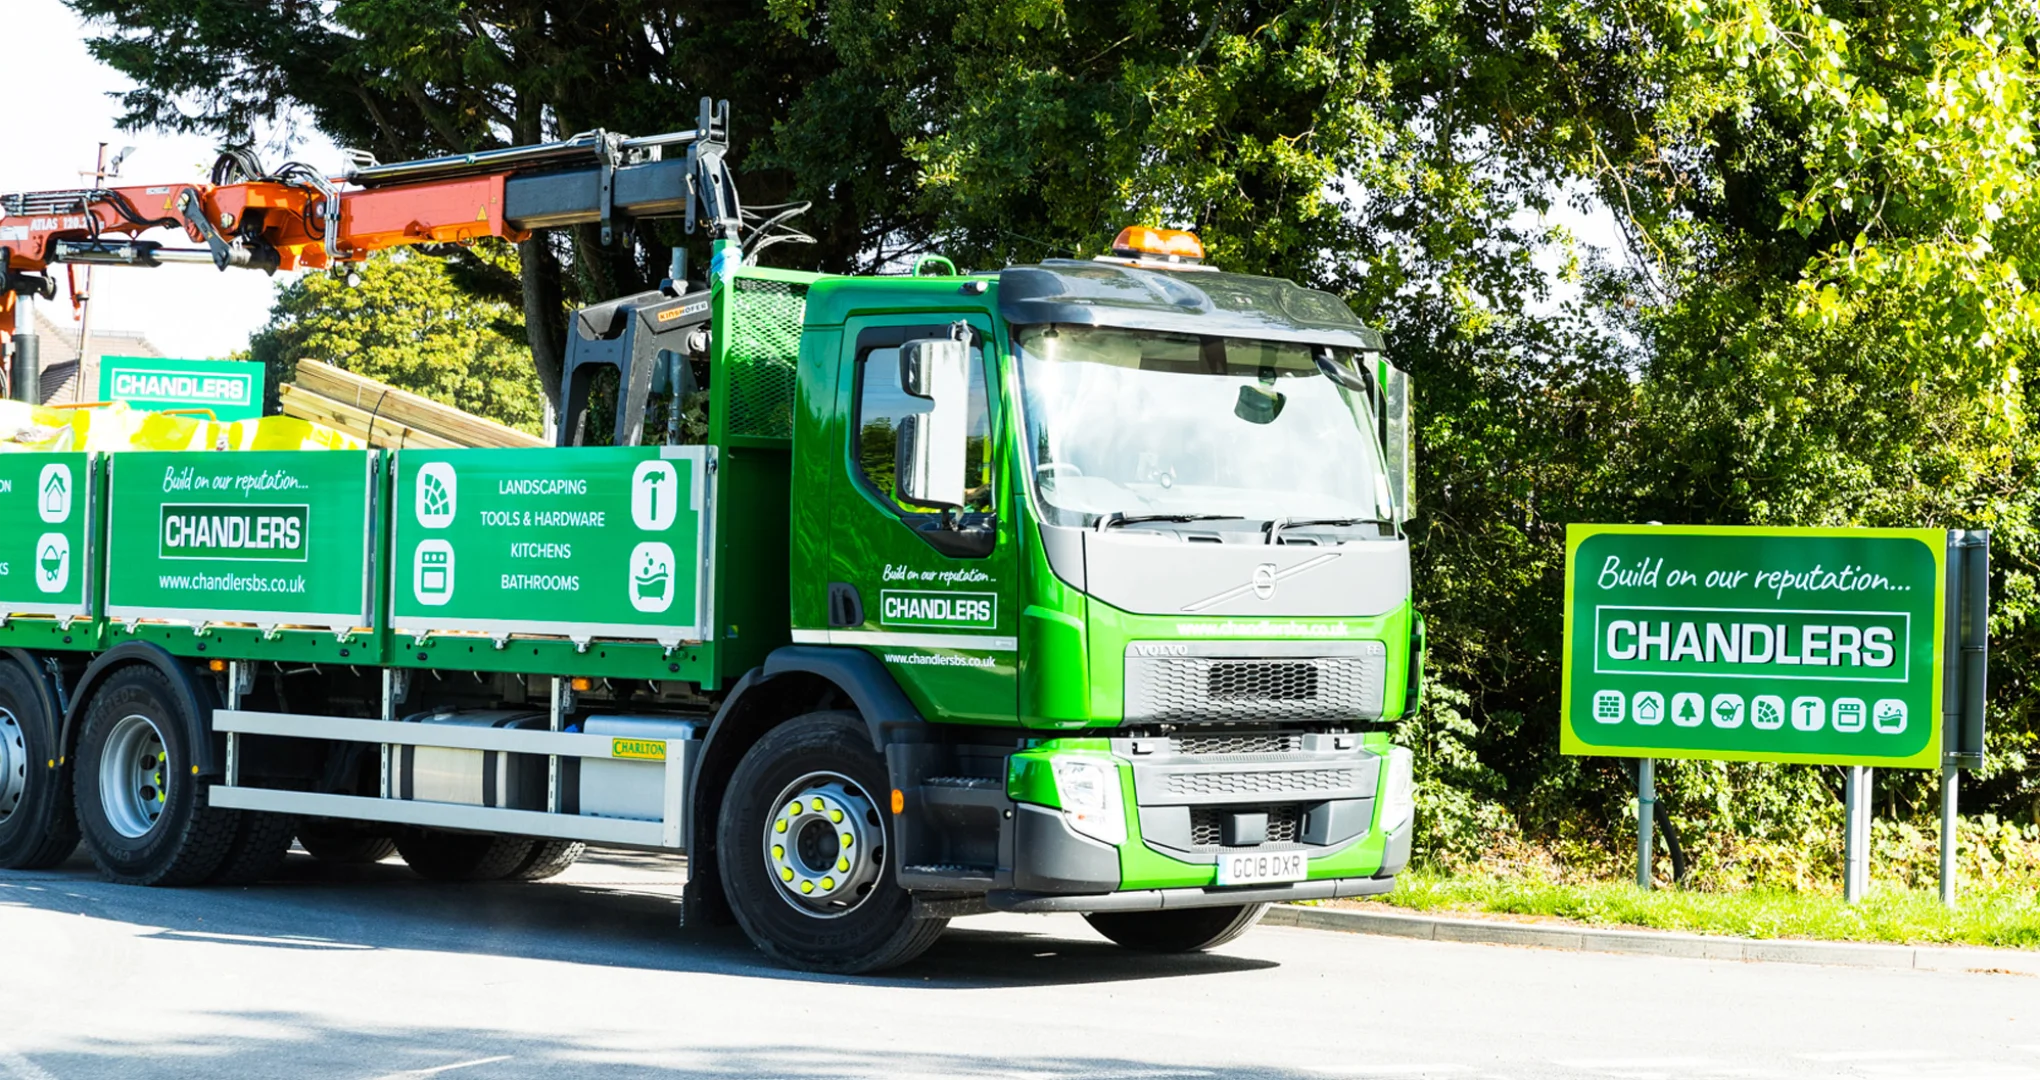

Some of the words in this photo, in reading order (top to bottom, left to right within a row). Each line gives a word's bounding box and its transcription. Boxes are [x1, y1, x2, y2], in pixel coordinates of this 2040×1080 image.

[115, 374, 244, 400] CHANDLERS
[162, 465, 194, 493] Build
[194, 475, 209, 489] on
[212, 475, 233, 489] our
[234, 469, 309, 498] reputation...
[498, 479, 587, 495] LANDSCAPING
[480, 511, 520, 527] TOOLS
[522, 511, 531, 527] &
[534, 511, 606, 527] HARDWARE
[165, 515, 301, 550] CHANDLERS
[511, 543, 572, 559] KITCHENS
[159, 572, 306, 593] www.chandlersbs.co.uk
[501, 574, 580, 591] BATHROOMS
[882, 563, 908, 582] Build
[907, 570, 920, 581] on
[920, 570, 938, 582] our
[1597, 555, 1664, 590] Build
[1666, 569, 1698, 588] on
[1704, 569, 1749, 590] our
[1753, 563, 1912, 600] reputation...
[885, 597, 991, 622] CHANDLERS
[1134, 644, 1188, 656] VOLVO
[1605, 619, 1896, 668] CHANDLERS
[885, 652, 996, 667] www.chandlersbs.co.uk
[613, 741, 665, 756] CHARLTON
[1233, 857, 1268, 879] GC18
[1272, 855, 1301, 877] DXR
